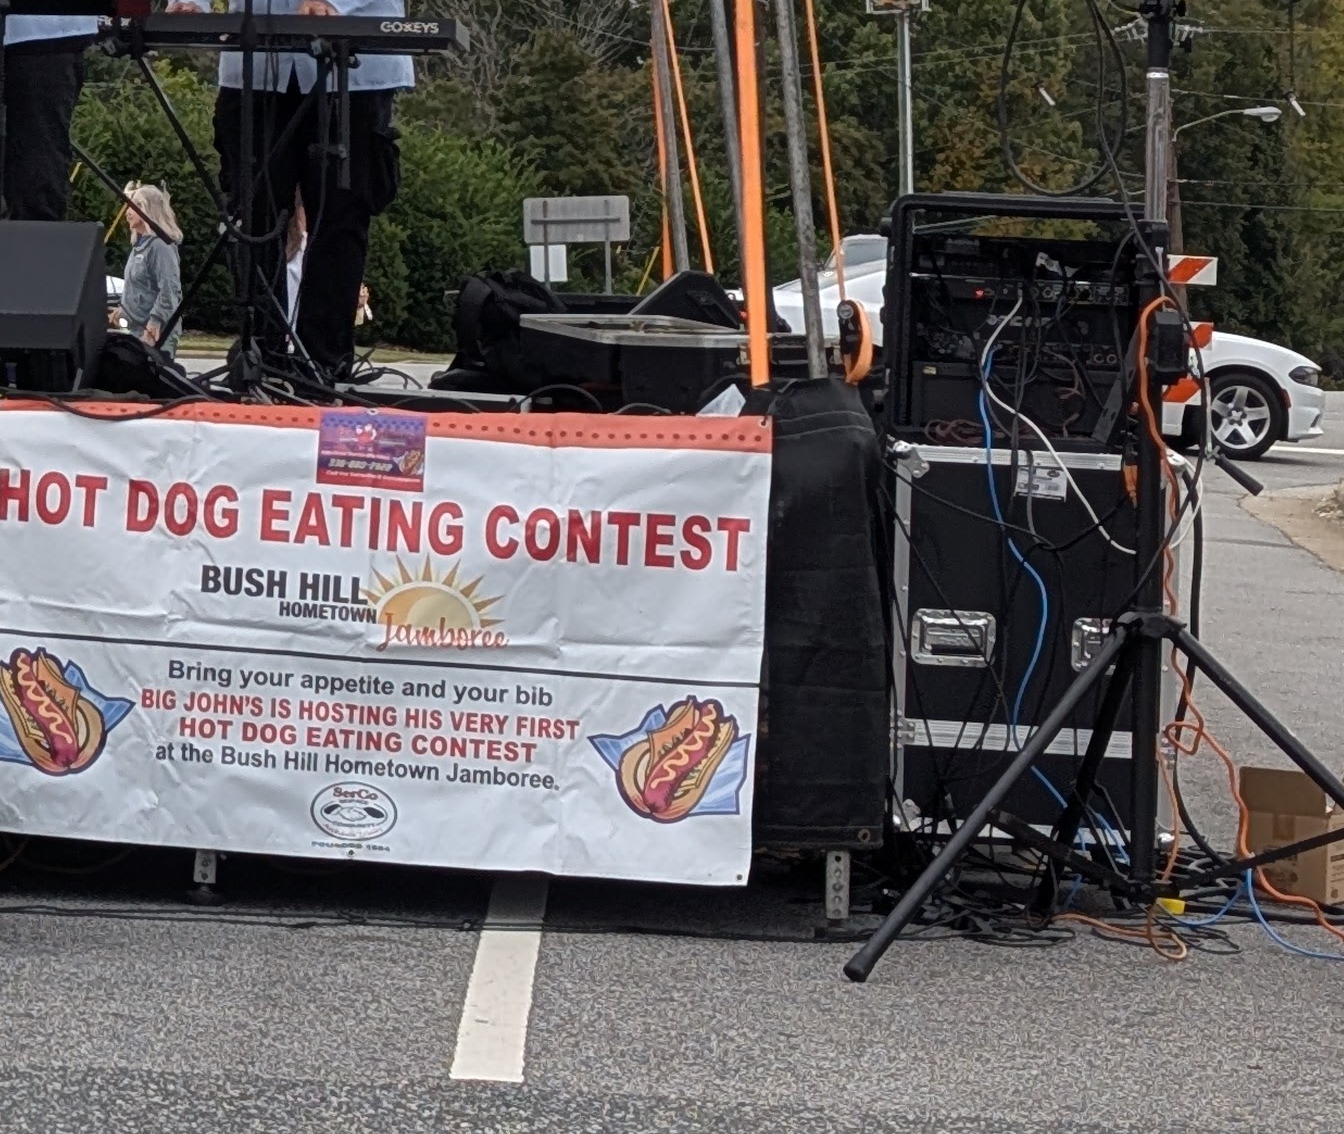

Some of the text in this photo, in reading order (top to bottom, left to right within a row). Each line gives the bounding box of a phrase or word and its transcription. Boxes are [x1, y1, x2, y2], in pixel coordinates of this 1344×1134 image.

[126, 479, 239, 539] DOG
[260, 488, 464, 556] EATING
[485, 504, 751, 571] CONTEST
[201, 565, 368, 605] BUSH HILL
[279, 601, 377, 624] HOMETOWN
[376, 612, 509, 652] Jamboree
[168, 660, 553, 707] Bring your appetite and your bib
[141, 688, 580, 740] BIG JOHN'S IS HOSTING HIS VERY FIRST
[179, 717, 537, 763] HOT DOG EATING CONTEST
[155, 742, 560, 791] at the Bush Hill Hometown Jamboree.
[332, 786, 379, 801] SerCo
